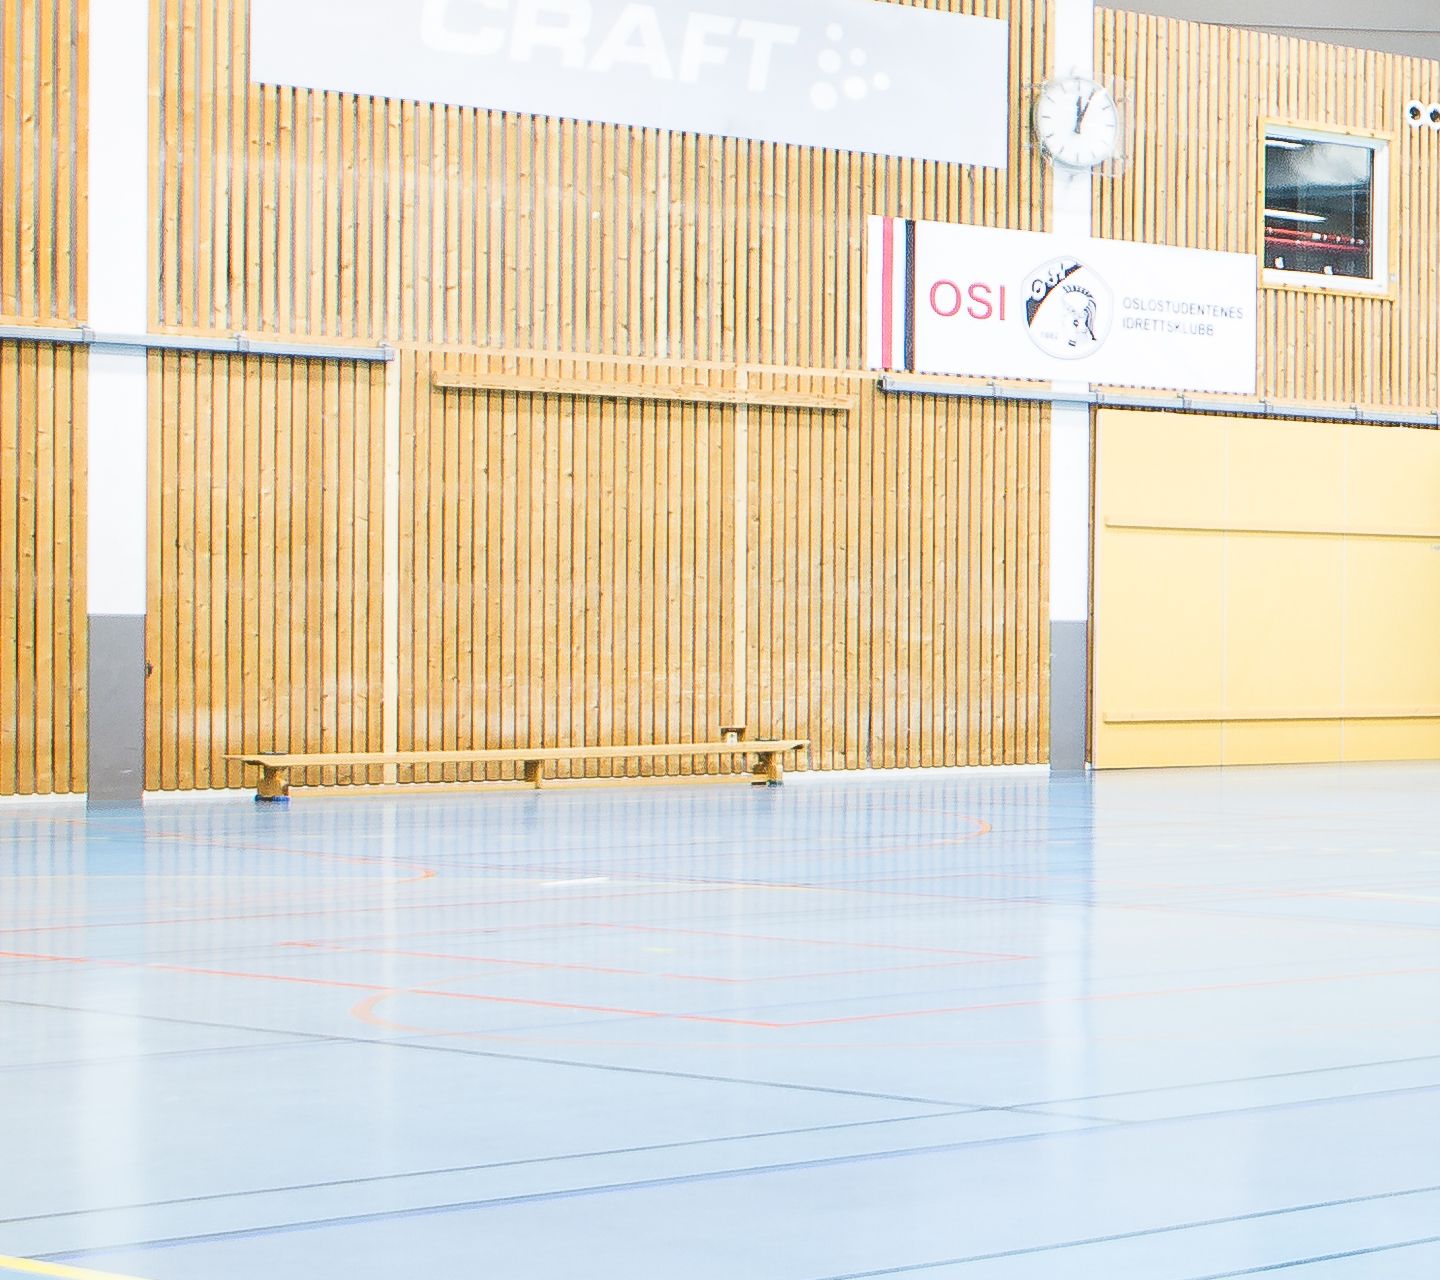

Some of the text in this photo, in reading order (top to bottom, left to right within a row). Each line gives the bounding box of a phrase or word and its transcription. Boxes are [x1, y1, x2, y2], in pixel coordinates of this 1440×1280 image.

[929, 279, 1006, 321] OSI
[1122, 296, 1244, 320] OSLOSTUDENTENES
[1122, 317, 1214, 337] IDRETTSKLUBB
